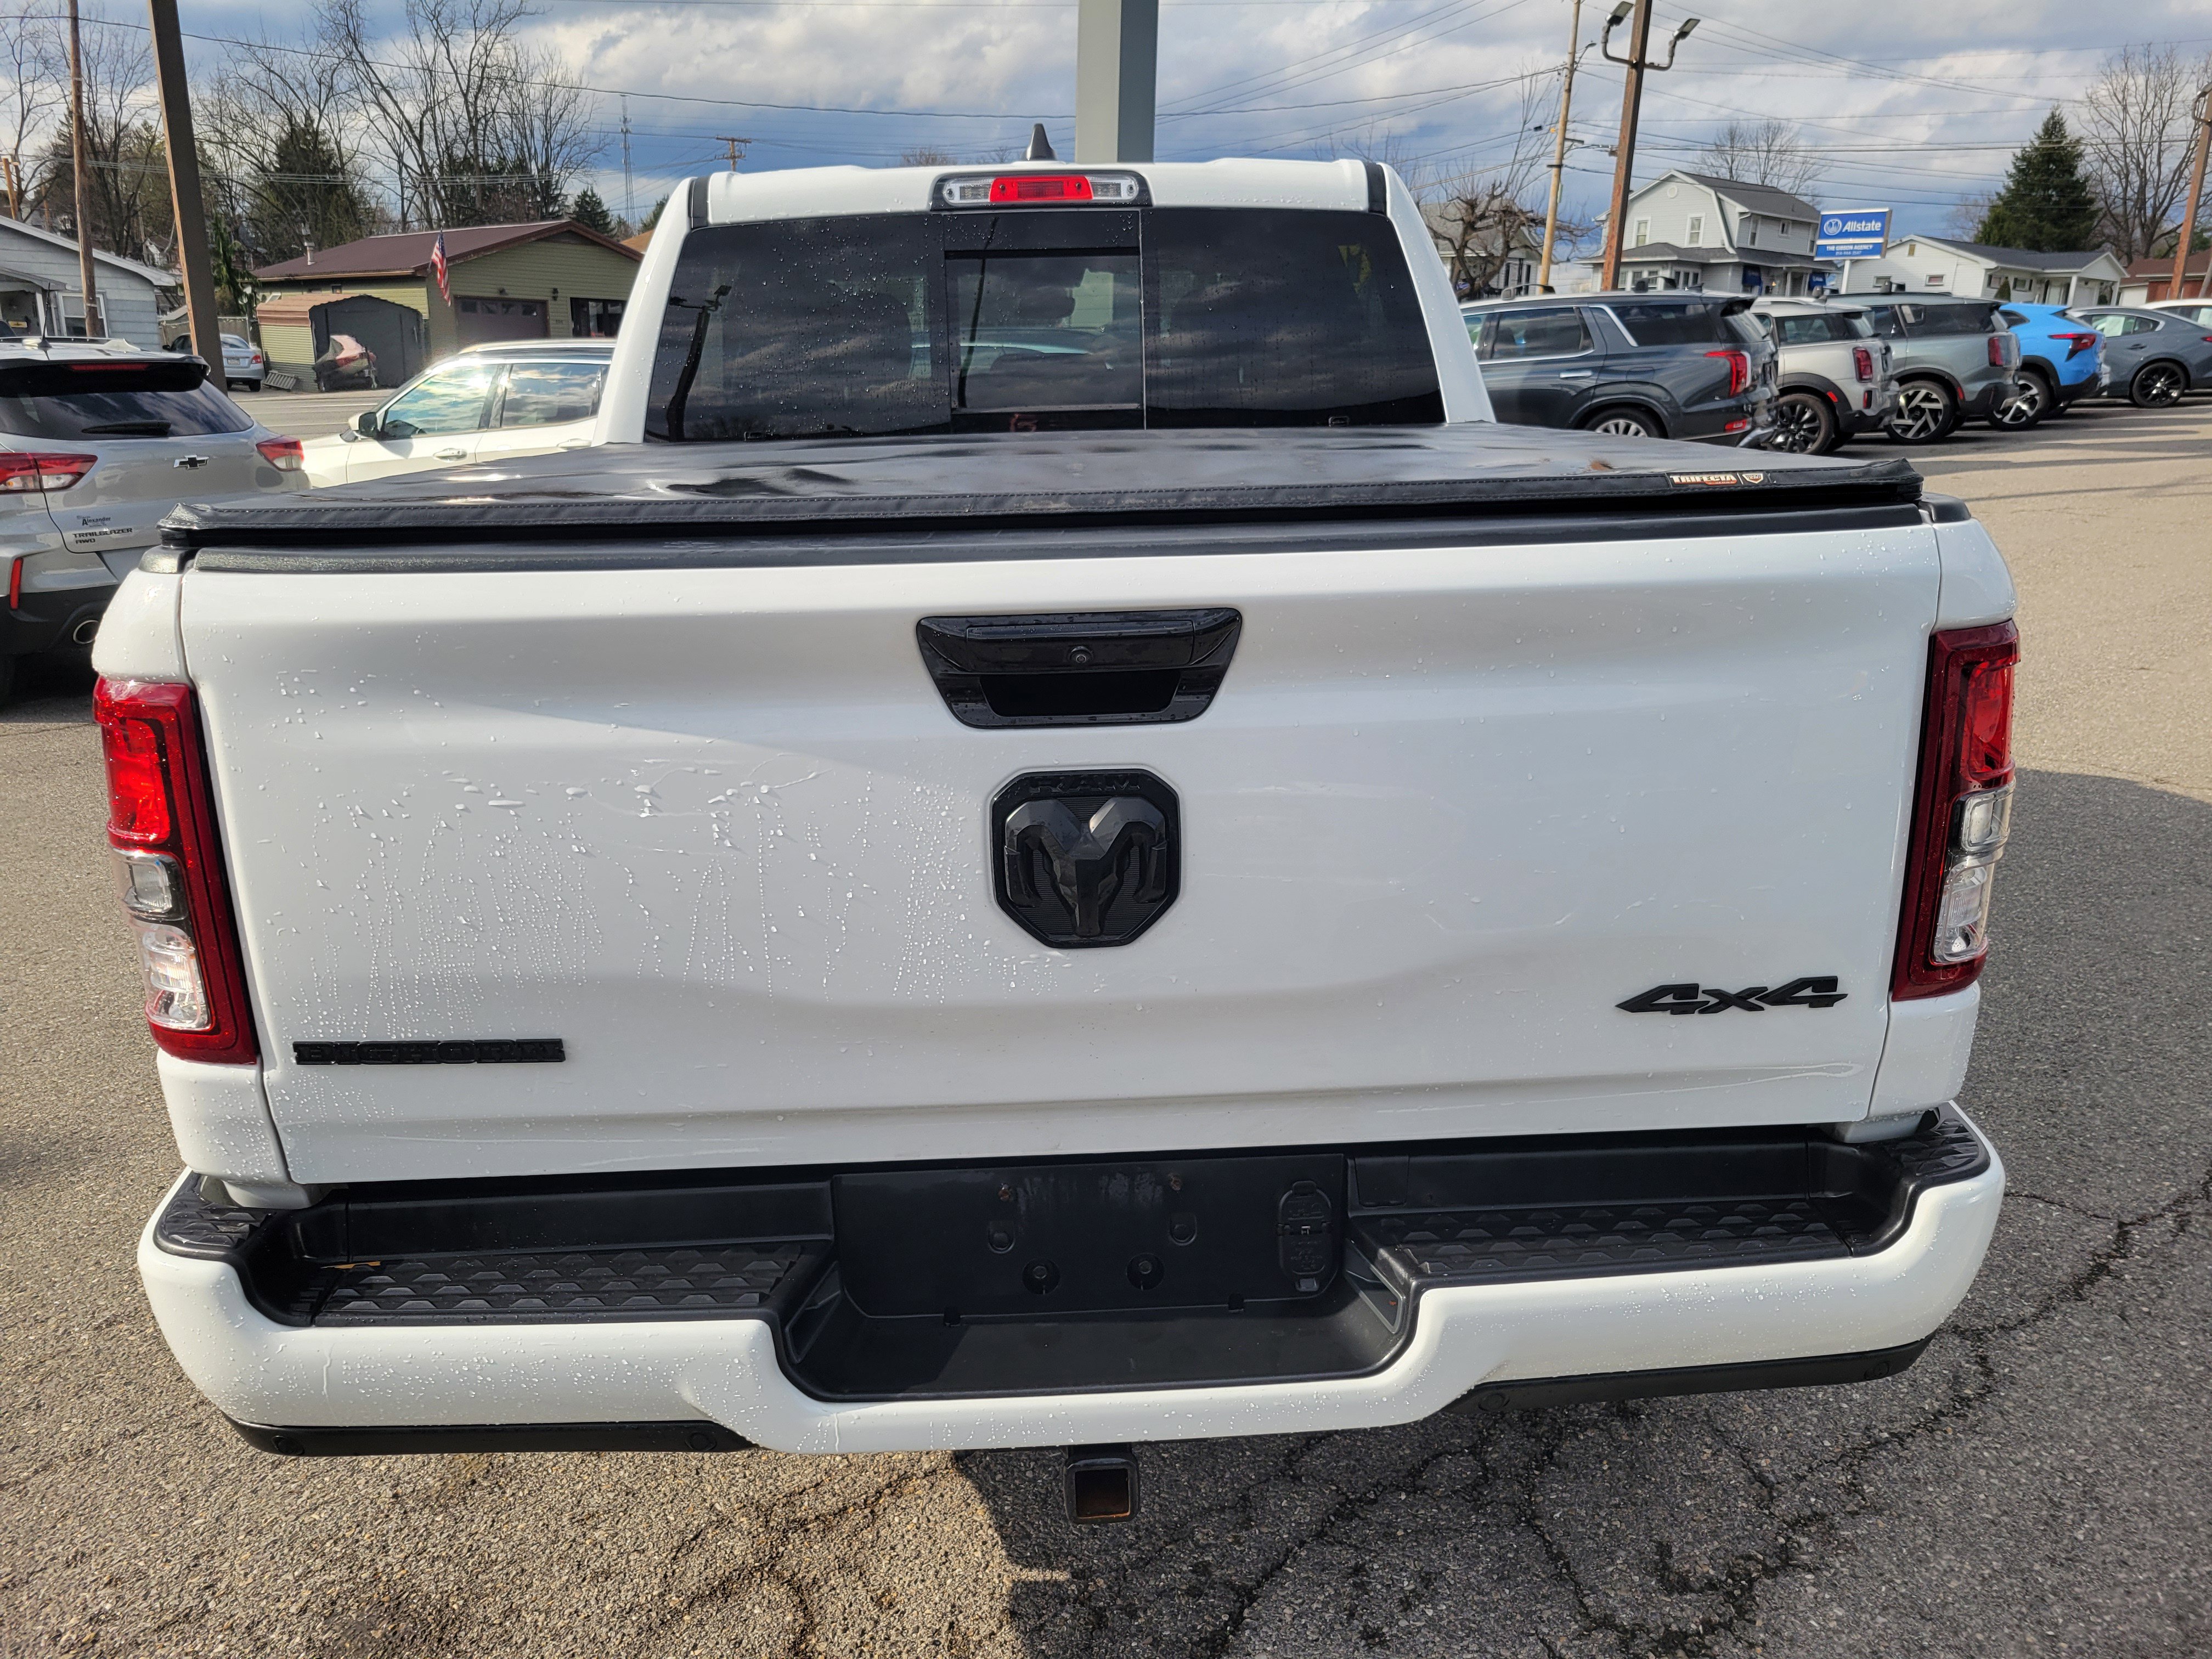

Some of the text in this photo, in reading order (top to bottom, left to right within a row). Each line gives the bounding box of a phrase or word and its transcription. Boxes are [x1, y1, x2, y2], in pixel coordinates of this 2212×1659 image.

[1842, 220, 1882, 232] Allstate
[82, 516, 111, 526] Alexander
[72, 528, 133, 538] TRAILBLAZER
[1029, 774, 1141, 793] RAM
[1615, 975, 1848, 1015] 4x4
